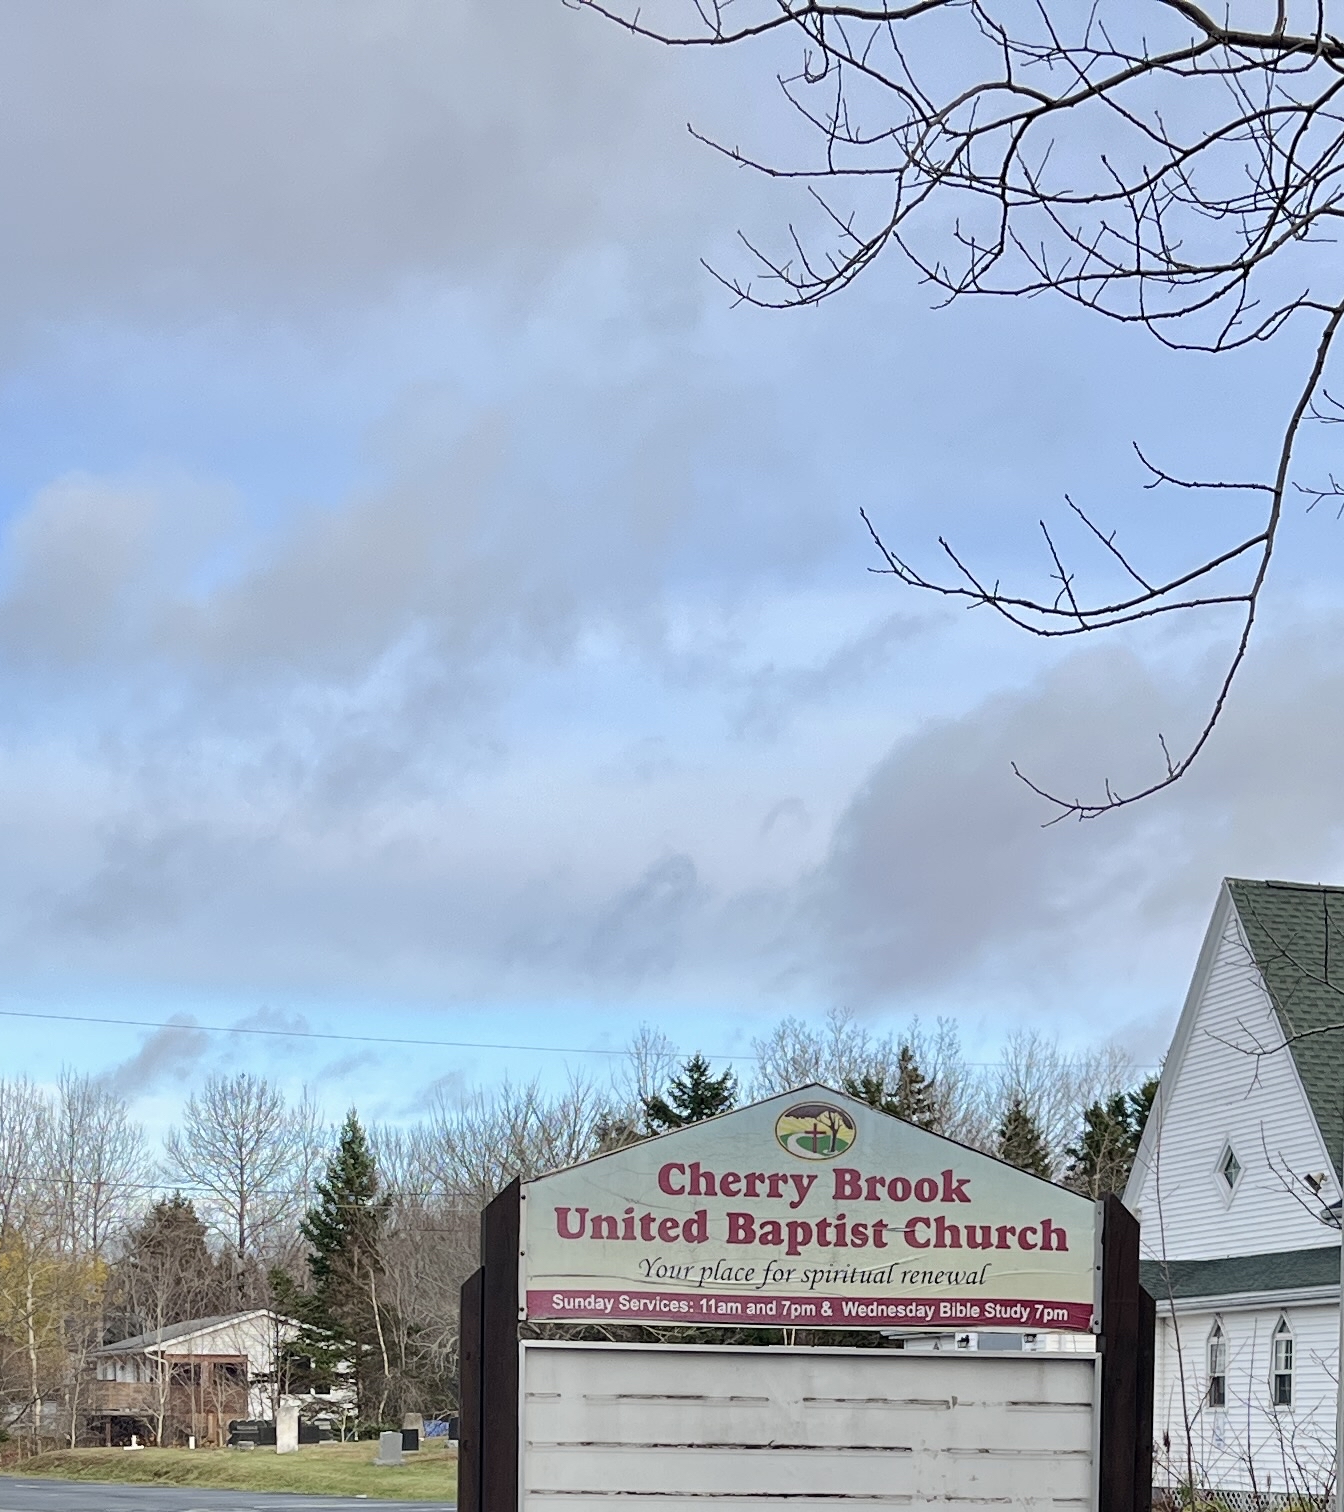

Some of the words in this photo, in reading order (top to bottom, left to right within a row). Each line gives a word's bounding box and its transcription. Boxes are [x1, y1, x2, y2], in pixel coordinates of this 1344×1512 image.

[658, 1162, 818, 1209] Cherry
[832, 1168, 972, 1203] Brook
[554, 1206, 709, 1244] United
[726, 1211, 889, 1256] Baptist
[903, 1215, 1070, 1252] Church
[638, 1257, 695, 1280] Your
[698, 1258, 756, 1287] place
[756, 1260, 797, 1290] for
[800, 1262, 900, 1290] spiritual
[900, 1262, 993, 1286] renewal
[552, 1294, 614, 1314] Sunday
[618, 1295, 694, 1313] Services:
[699, 1298, 742, 1315] 11am
[746, 1299, 777, 1316] and
[781, 1300, 817, 1318] 7pm
[820, 1301, 834, 1317] &
[842, 1301, 935, 1321] Wednesday
[939, 1302, 981, 1319] Bible
[984, 1303, 1030, 1322] Study
[1034, 1304, 1069, 1322] 7pm
